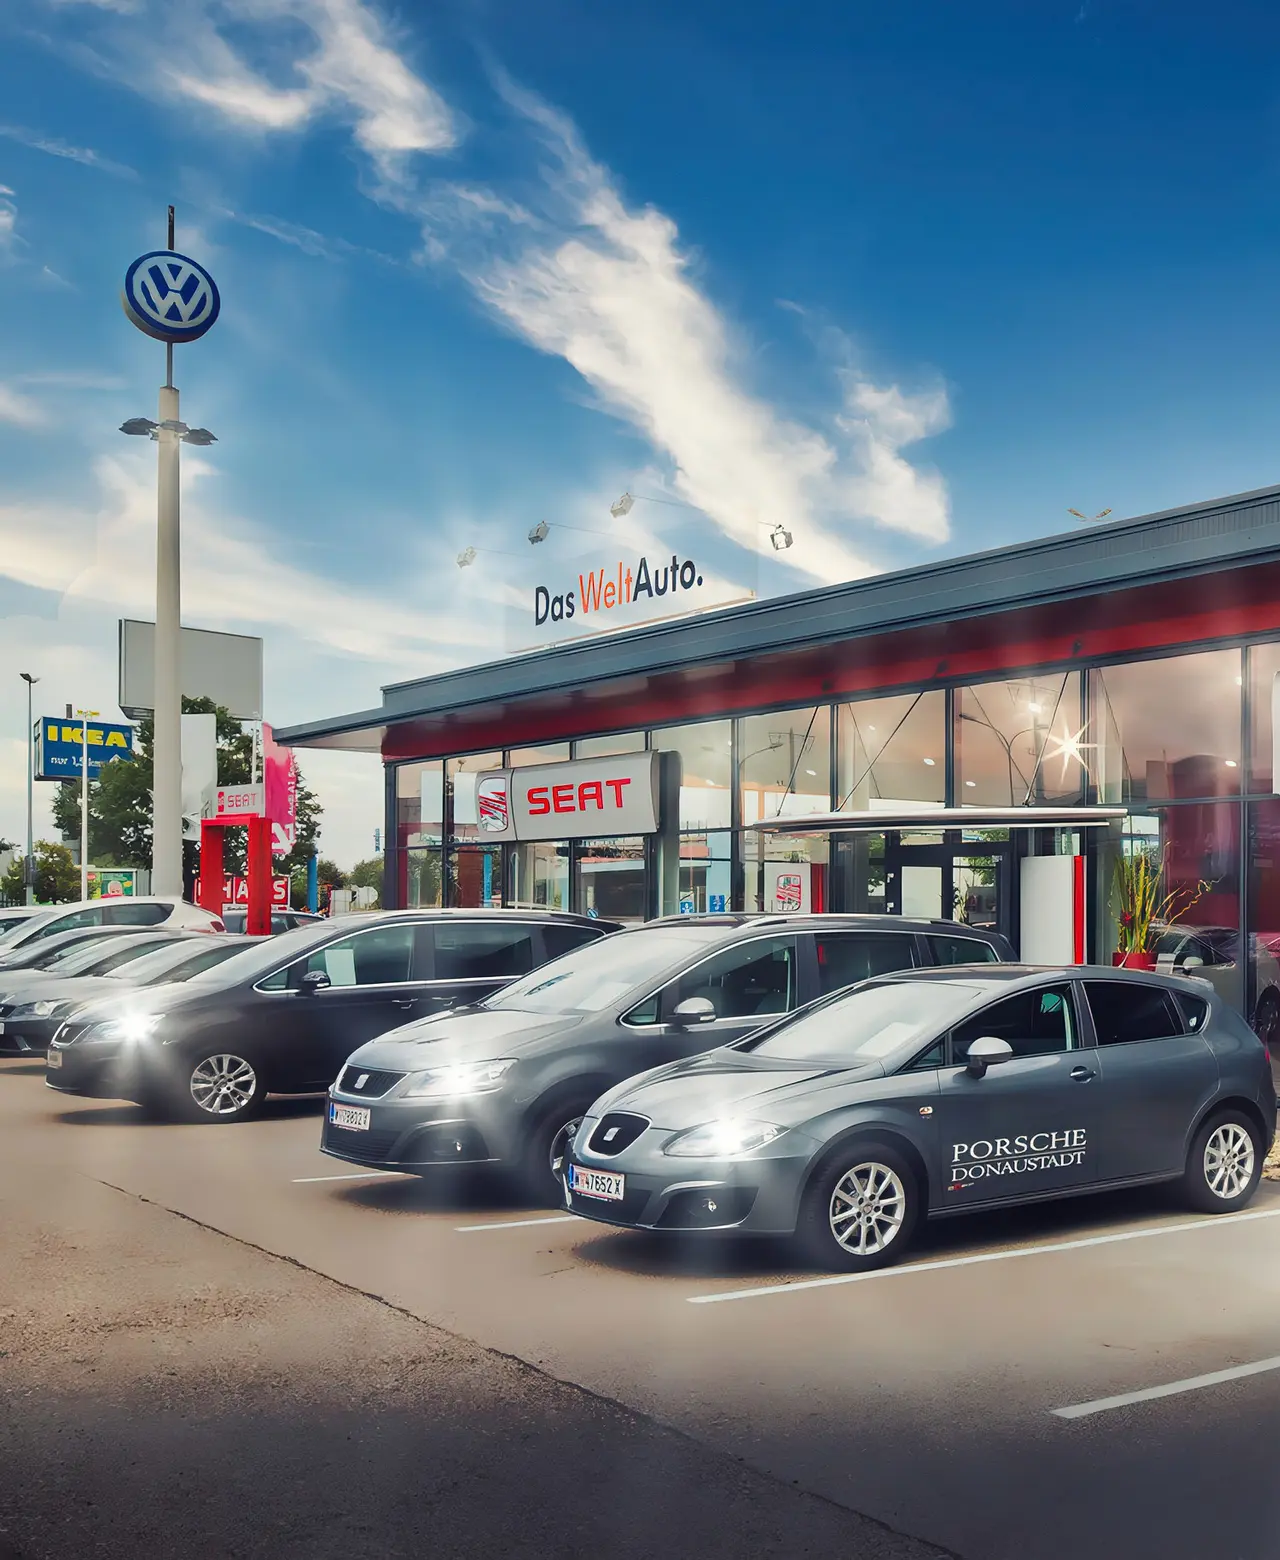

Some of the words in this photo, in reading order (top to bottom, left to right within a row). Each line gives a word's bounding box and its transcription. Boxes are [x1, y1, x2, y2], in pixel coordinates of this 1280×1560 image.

[535, 585, 575, 626] Das
[579, 555, 704, 614] WeltAuto.
[47, 725, 128, 748] IKEA
[227, 792, 257, 808] SEAT
[527, 777, 632, 816] SEAT
[951, 1128, 1087, 1163] PORSCHE
[951, 1150, 1086, 1182] DONAUSTADT
